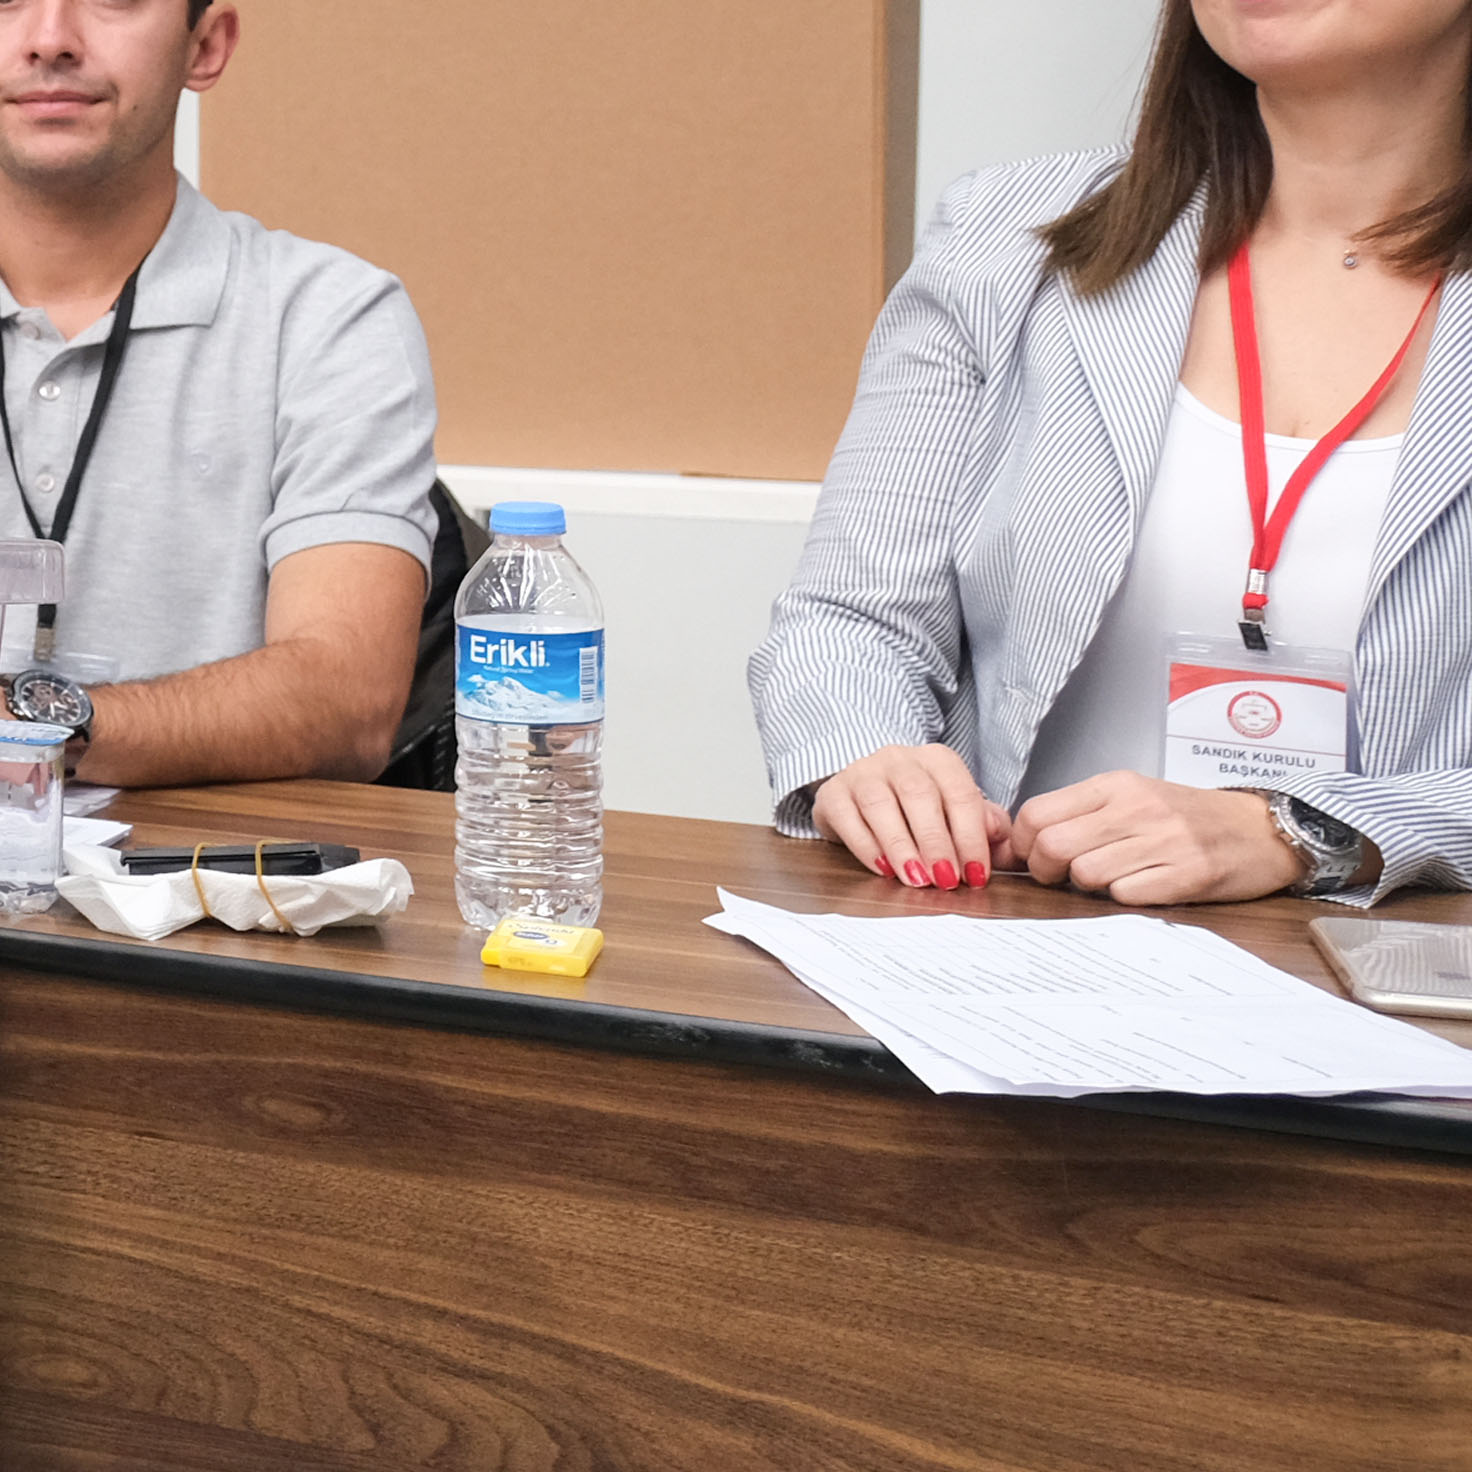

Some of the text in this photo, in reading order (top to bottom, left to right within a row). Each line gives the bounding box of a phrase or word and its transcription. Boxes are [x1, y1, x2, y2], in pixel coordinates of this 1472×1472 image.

[470, 634, 546, 667] Erikli
[1191, 744, 1316, 769] SANDIK KURULU
